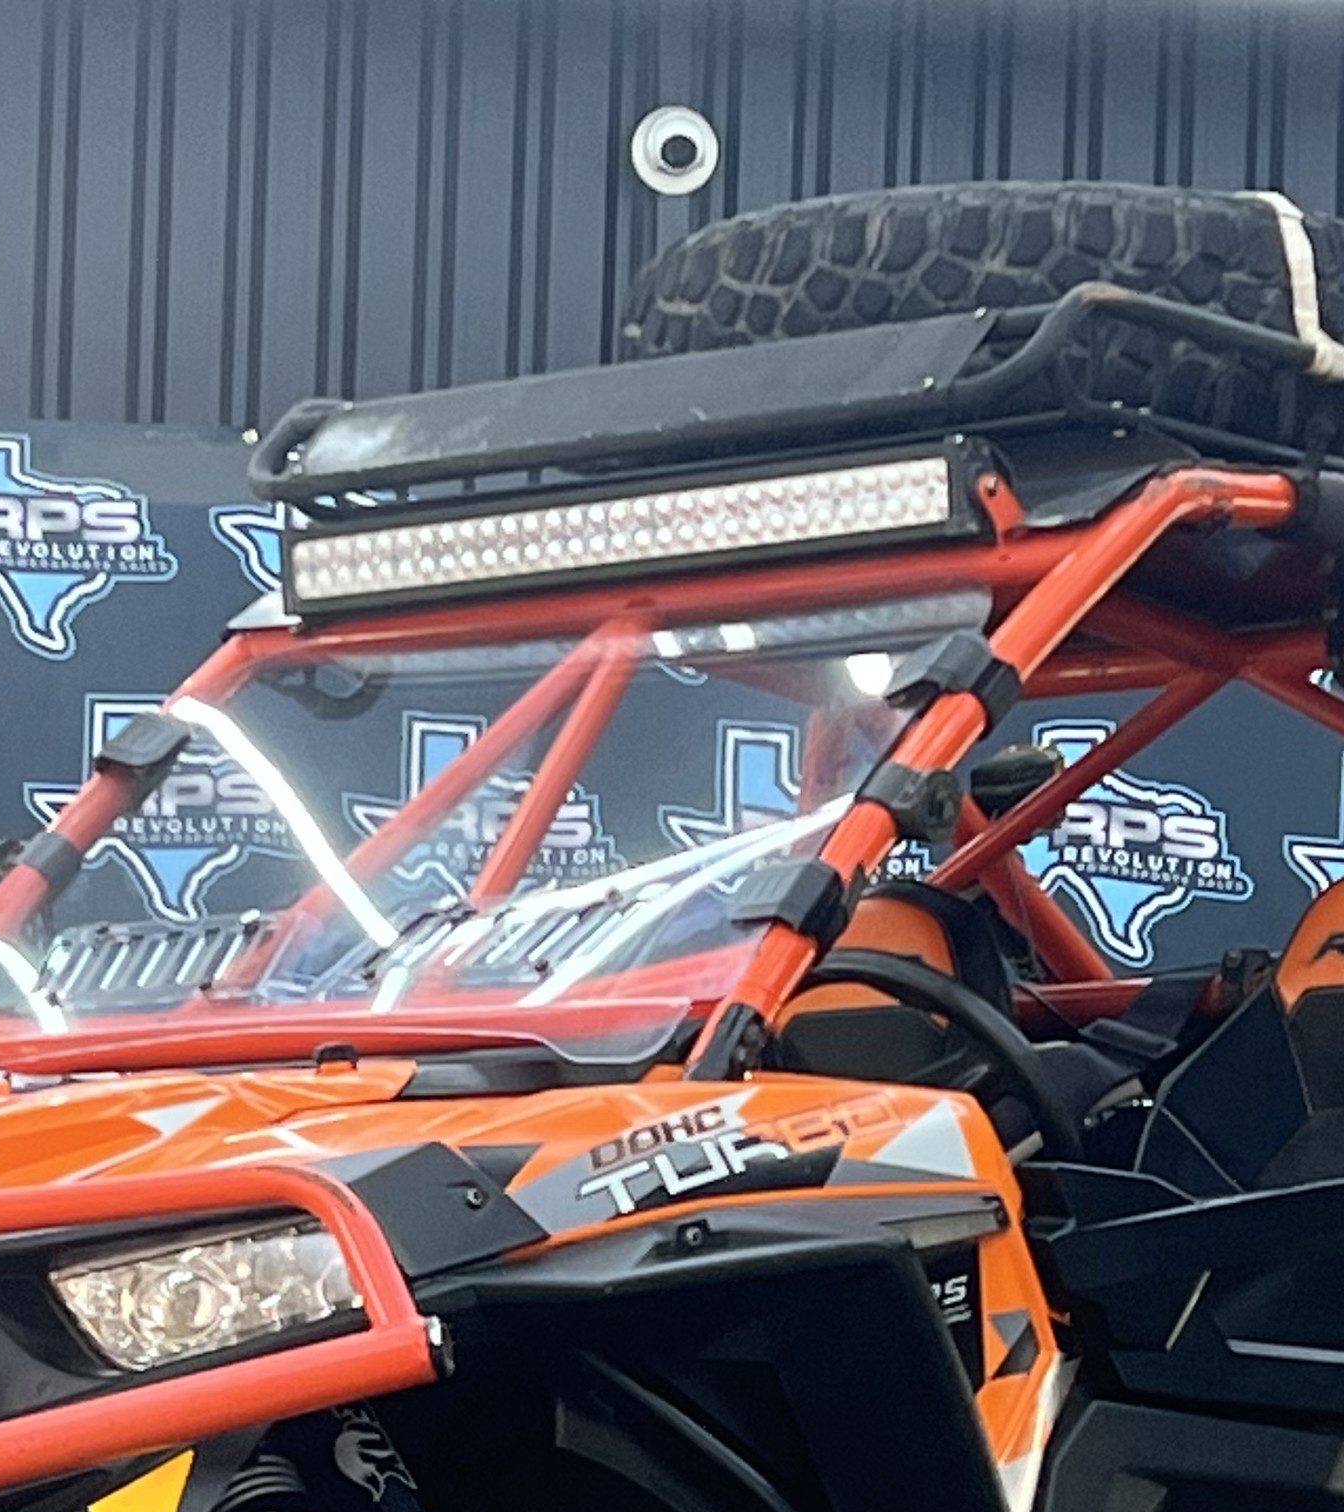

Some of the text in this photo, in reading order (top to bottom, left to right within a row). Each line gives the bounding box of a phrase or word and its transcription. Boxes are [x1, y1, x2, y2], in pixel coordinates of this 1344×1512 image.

[143, 773, 274, 816] PS
[113, 816, 287, 833] REVOLUTION
[1053, 803, 1218, 863] RPS
[436, 842, 605, 864] REVTION
[1063, 846, 1231, 879] REVOLUTION
[577, 1091, 907, 1215] TURBO
[589, 1105, 726, 1170] DOHC
